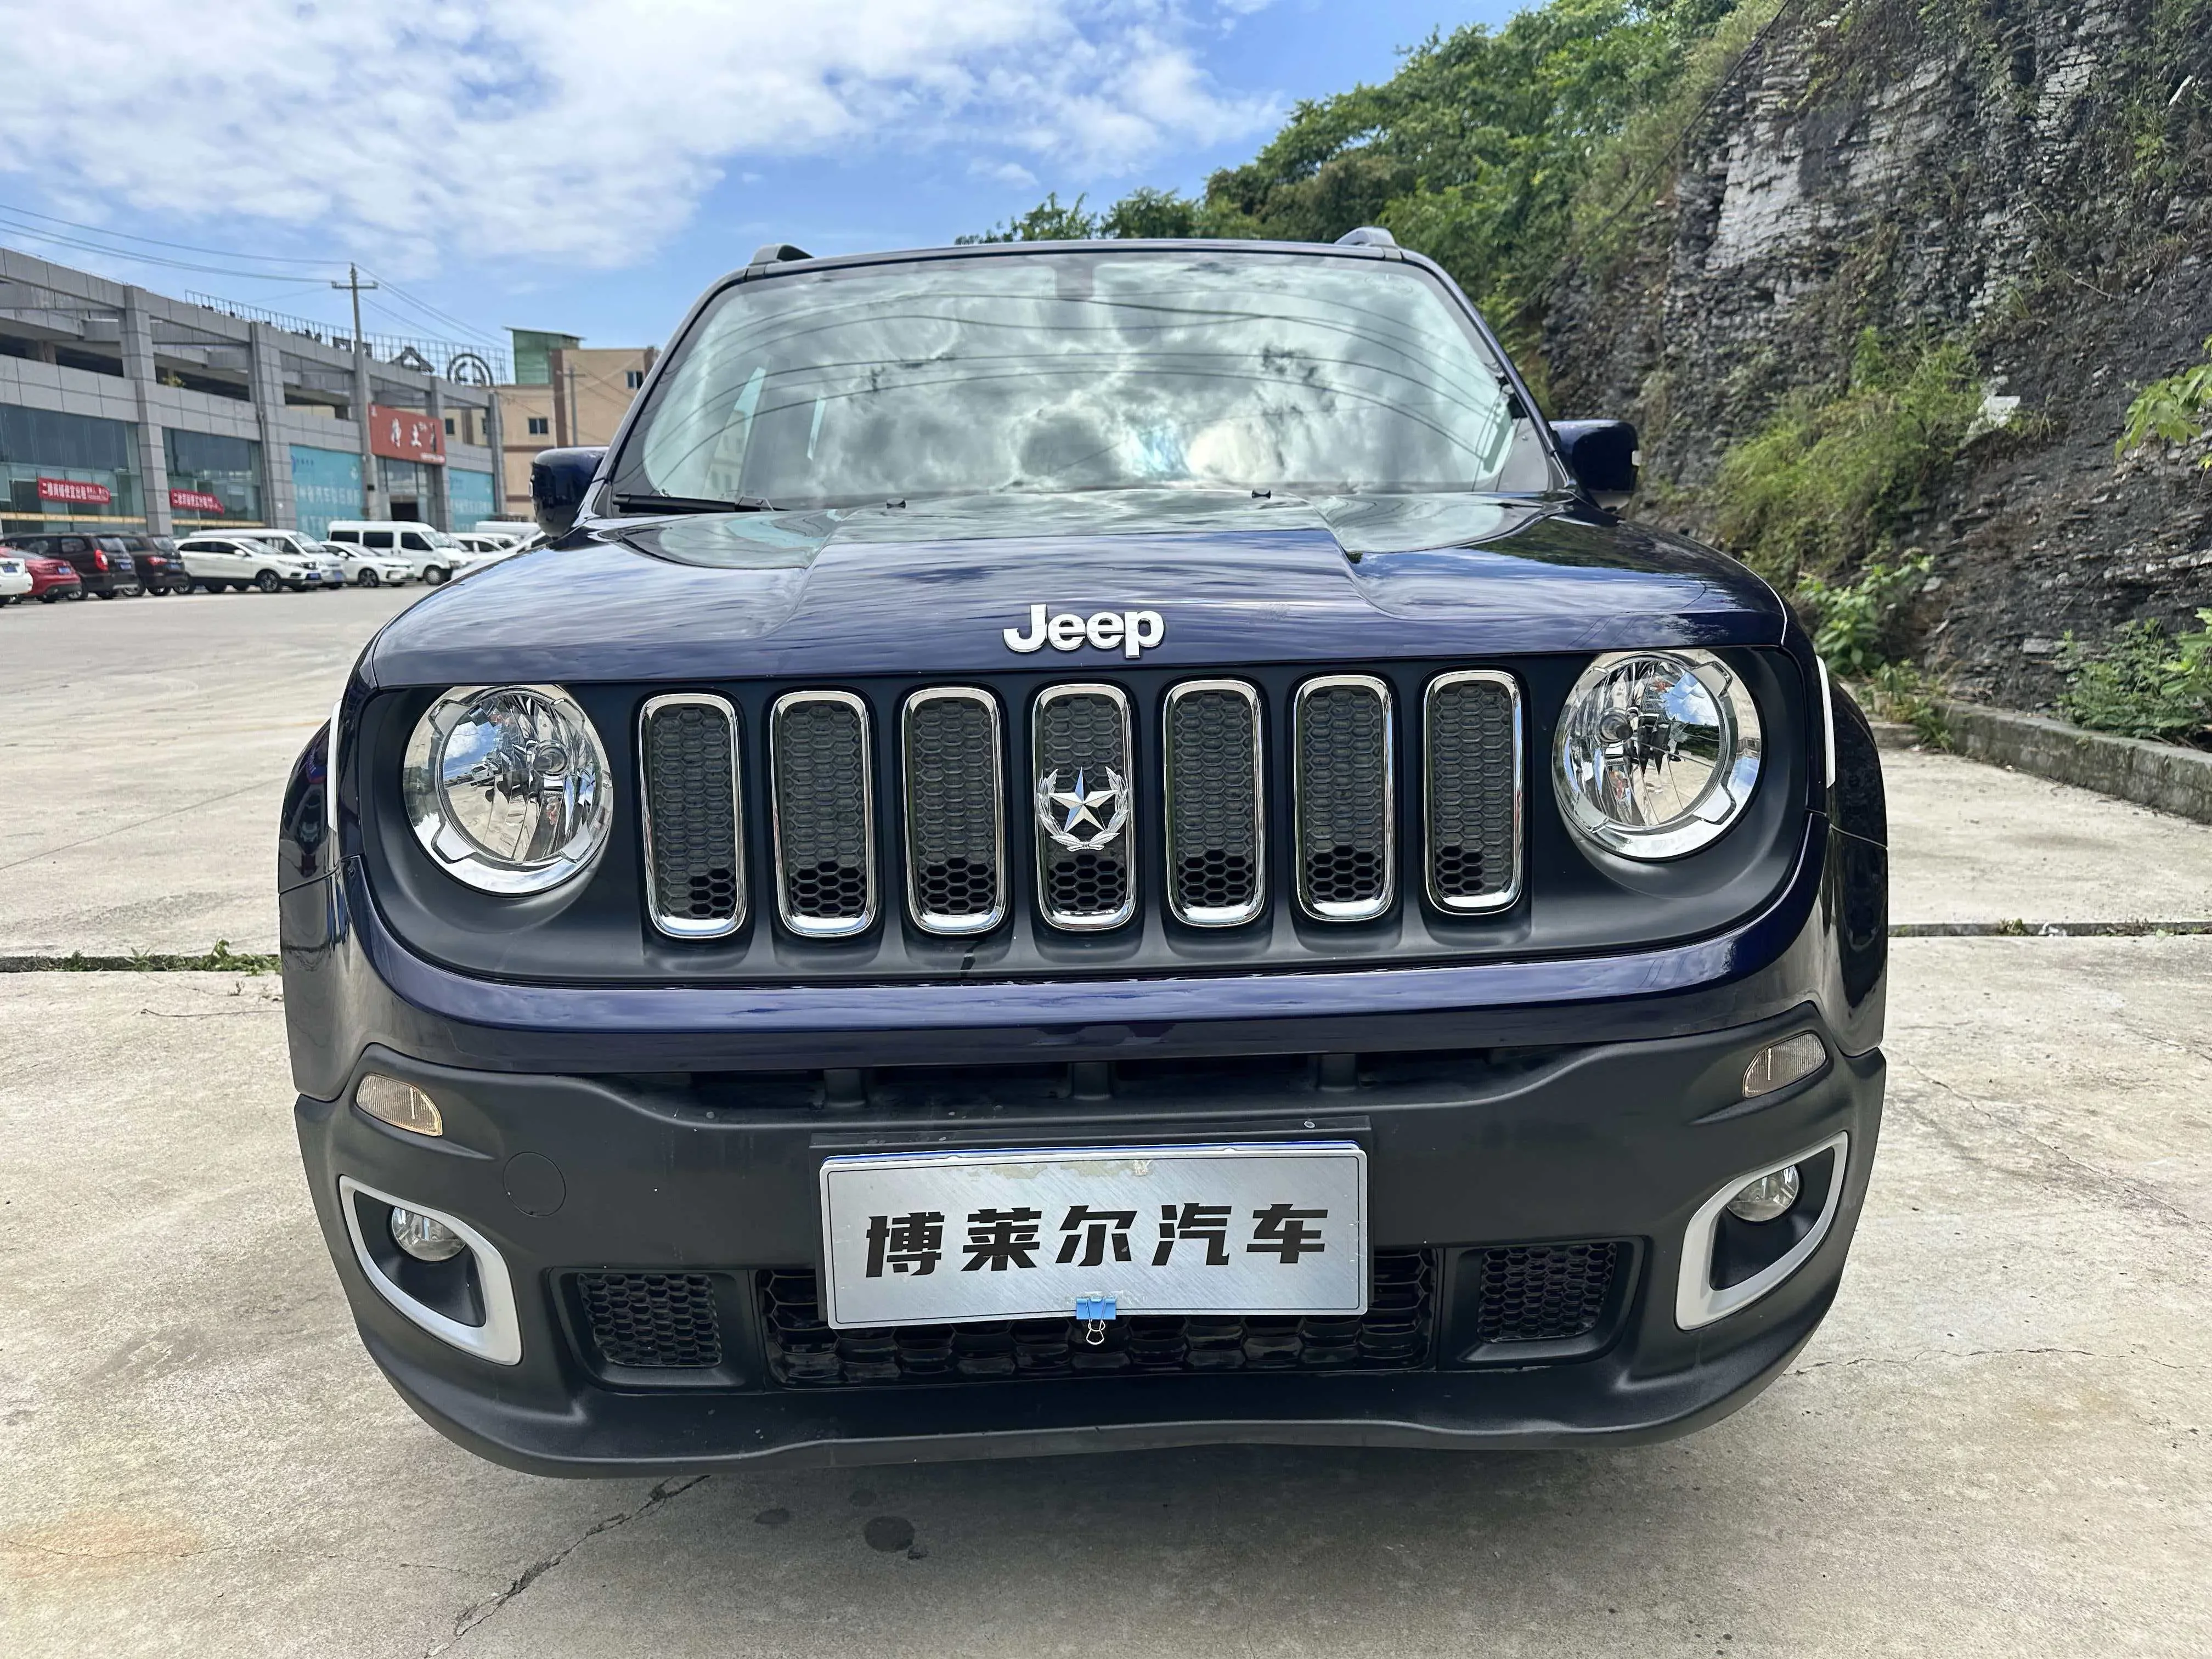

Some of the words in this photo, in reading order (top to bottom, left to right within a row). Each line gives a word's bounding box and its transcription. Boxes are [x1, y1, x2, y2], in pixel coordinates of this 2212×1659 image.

[1003, 604, 1164, 658] Jeep
[866, 1203, 1328, 1278] 博莱尔汽车
